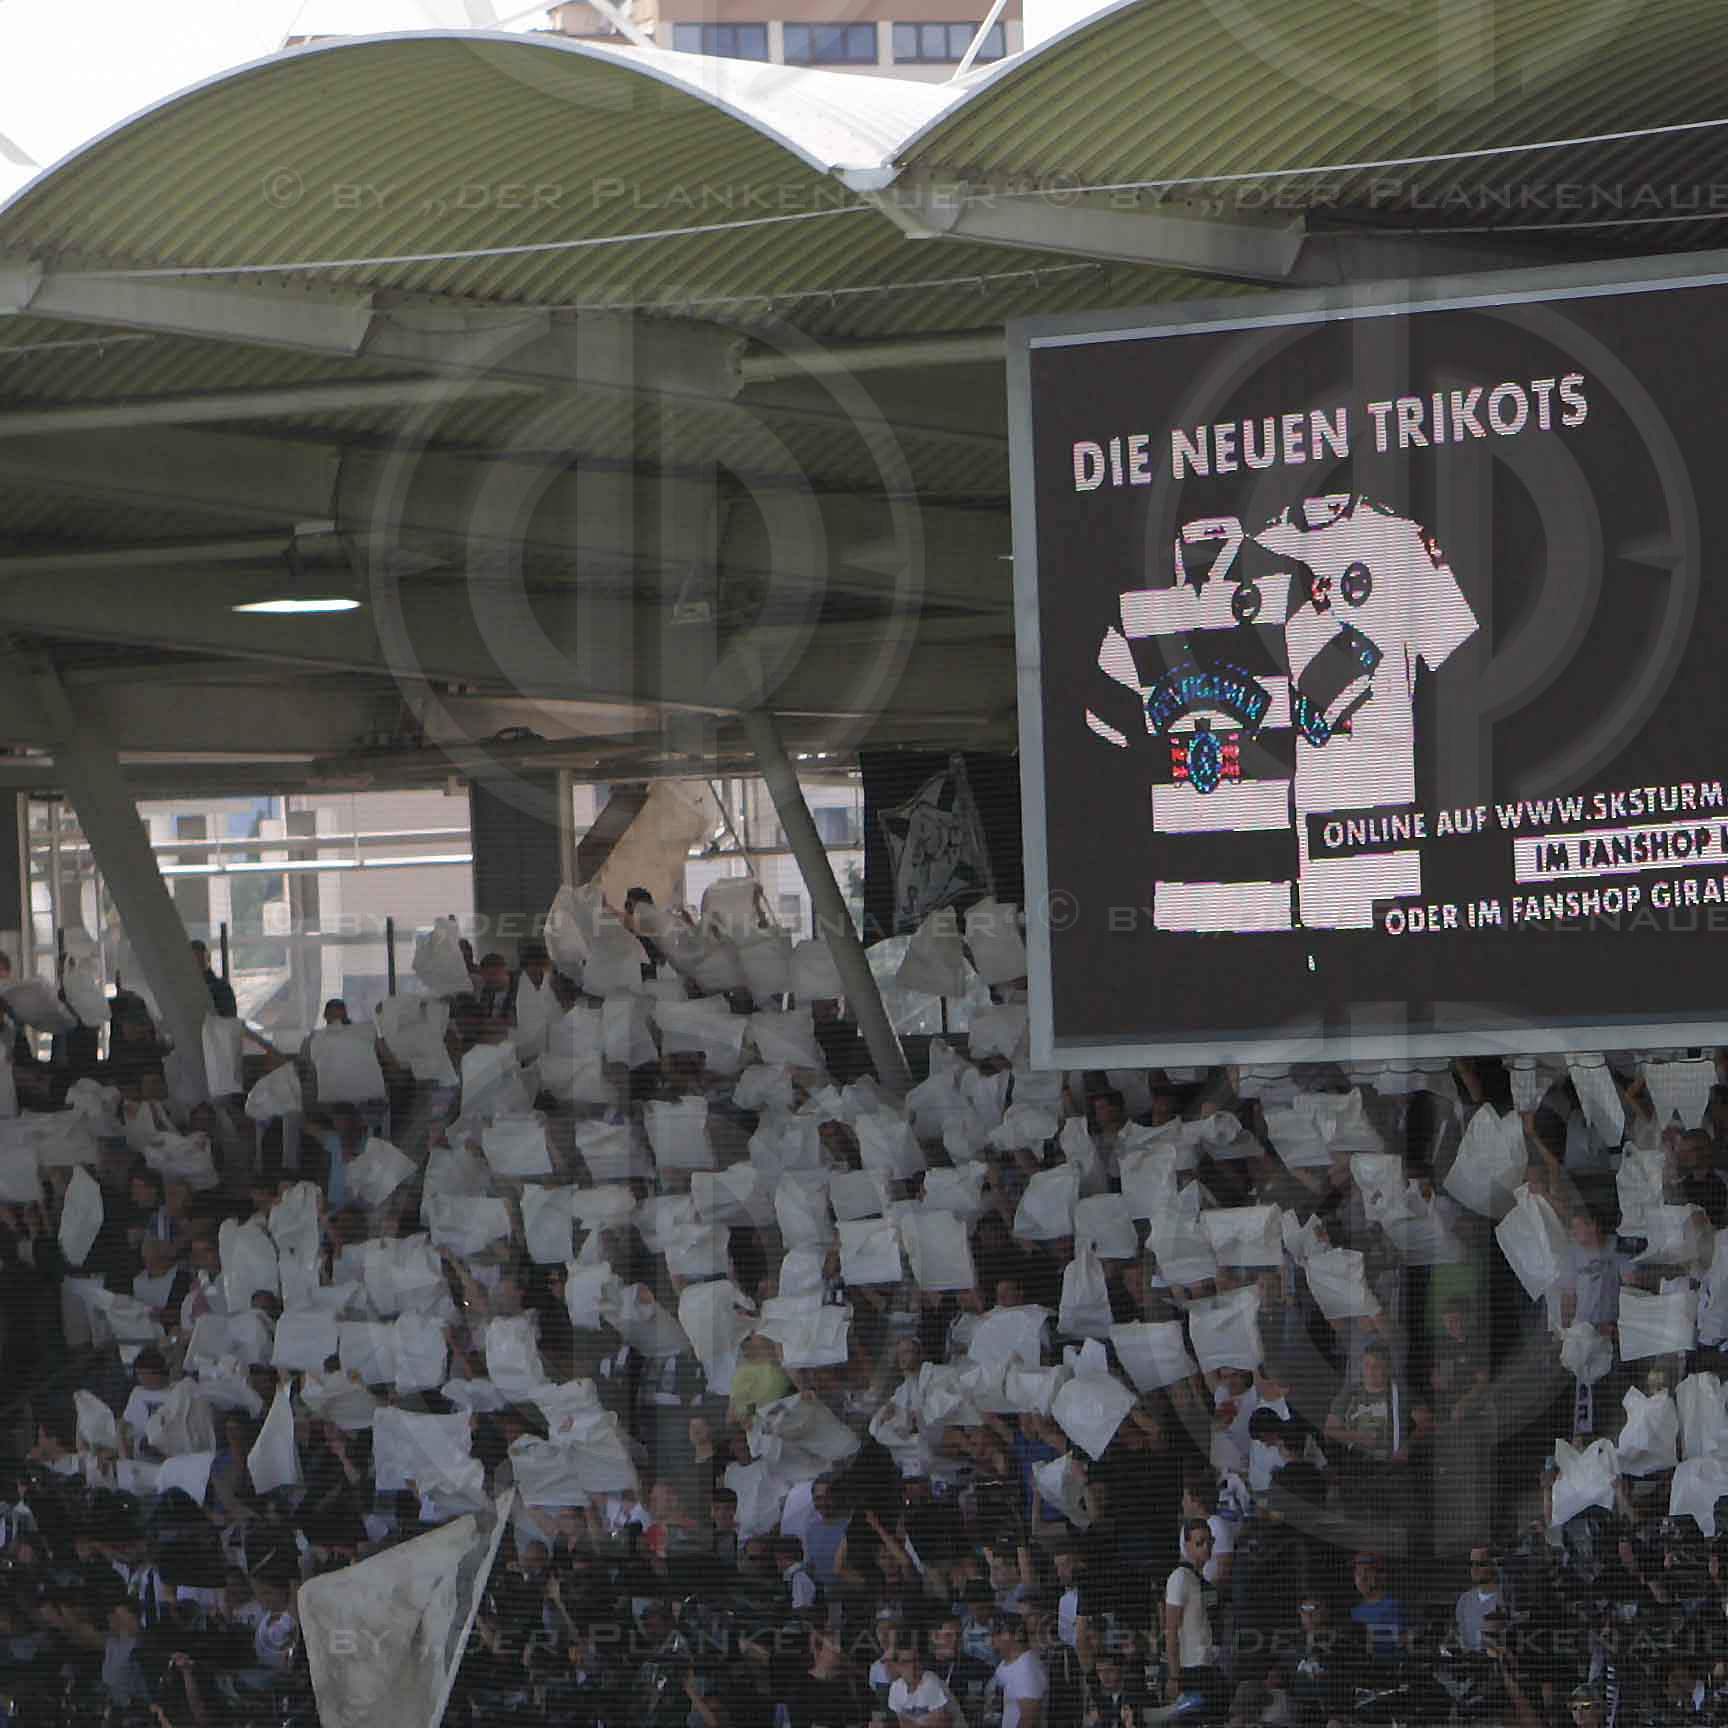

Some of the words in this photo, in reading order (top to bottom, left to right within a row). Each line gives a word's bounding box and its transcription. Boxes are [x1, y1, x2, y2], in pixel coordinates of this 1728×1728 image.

[1073, 434, 1152, 492] DIE
[1171, 407, 1350, 480] NEUEN
[1368, 372, 1589, 453] TRIKOTS
[1322, 812, 1427, 849] ONLINE
[1435, 806, 1488, 837] AUF
[1535, 841, 1570, 872] IM
[1579, 825, 1712, 871] FANSHOP
[1384, 903, 1459, 938] ODER
[1467, 898, 1503, 930] IM
[1511, 880, 1642, 924] FANSHOP
